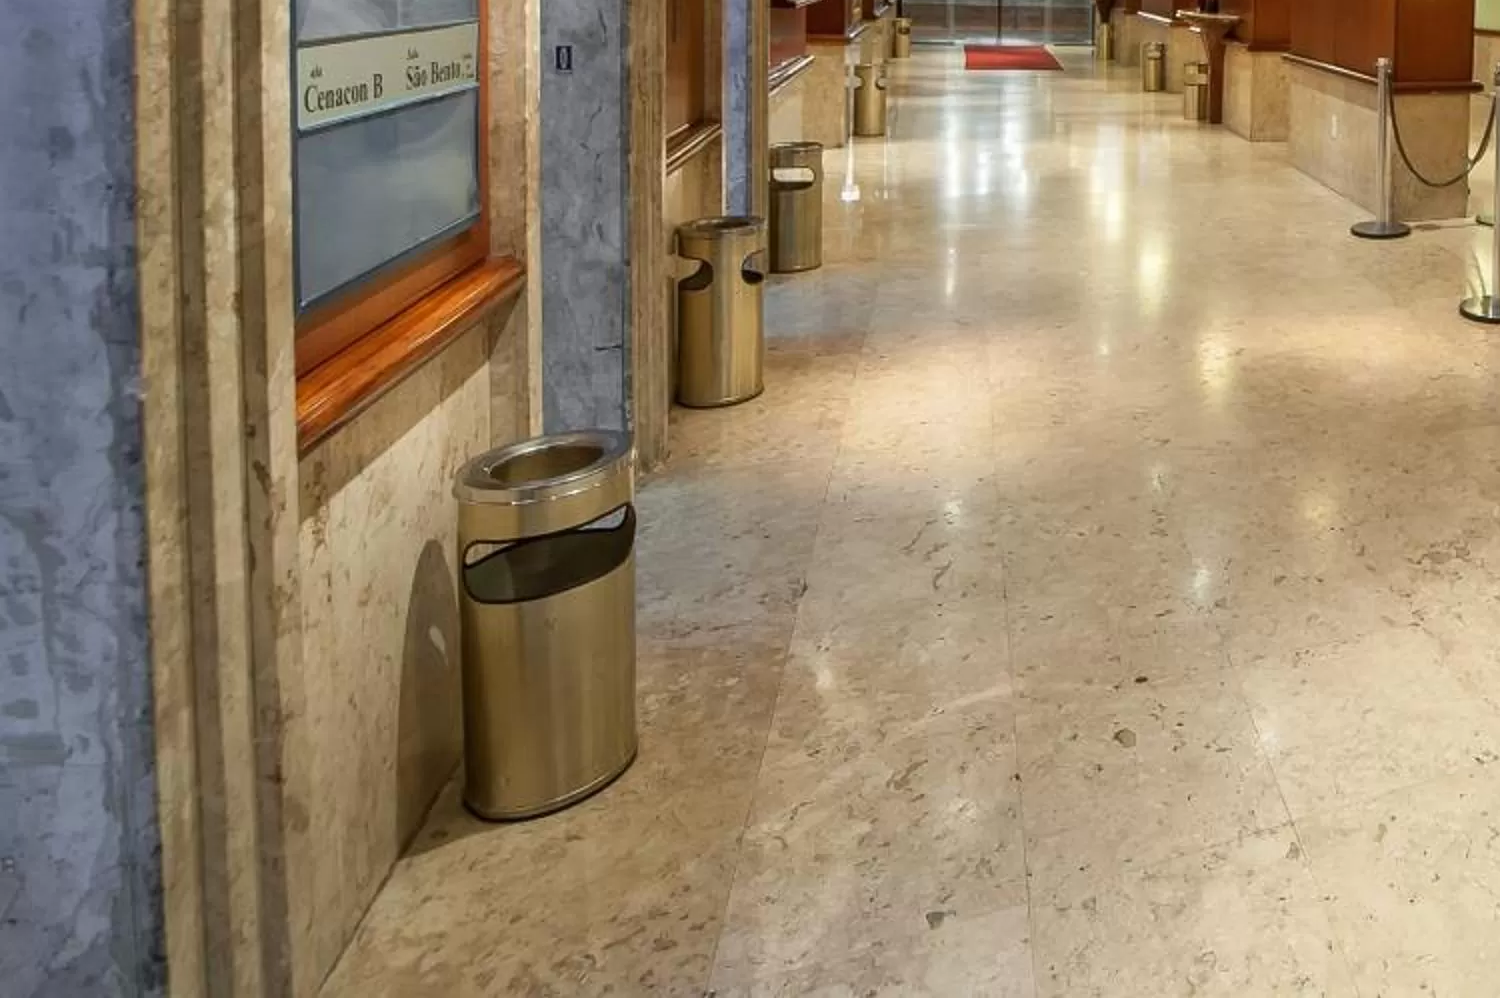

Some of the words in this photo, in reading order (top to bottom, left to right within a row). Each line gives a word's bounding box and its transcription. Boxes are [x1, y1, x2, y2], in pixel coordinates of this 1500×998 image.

[303, 80, 369, 114] Cenacon
[372, 73, 384, 100] B
[405, 65, 428, 91] São
[431, 60, 461, 85] Bento
